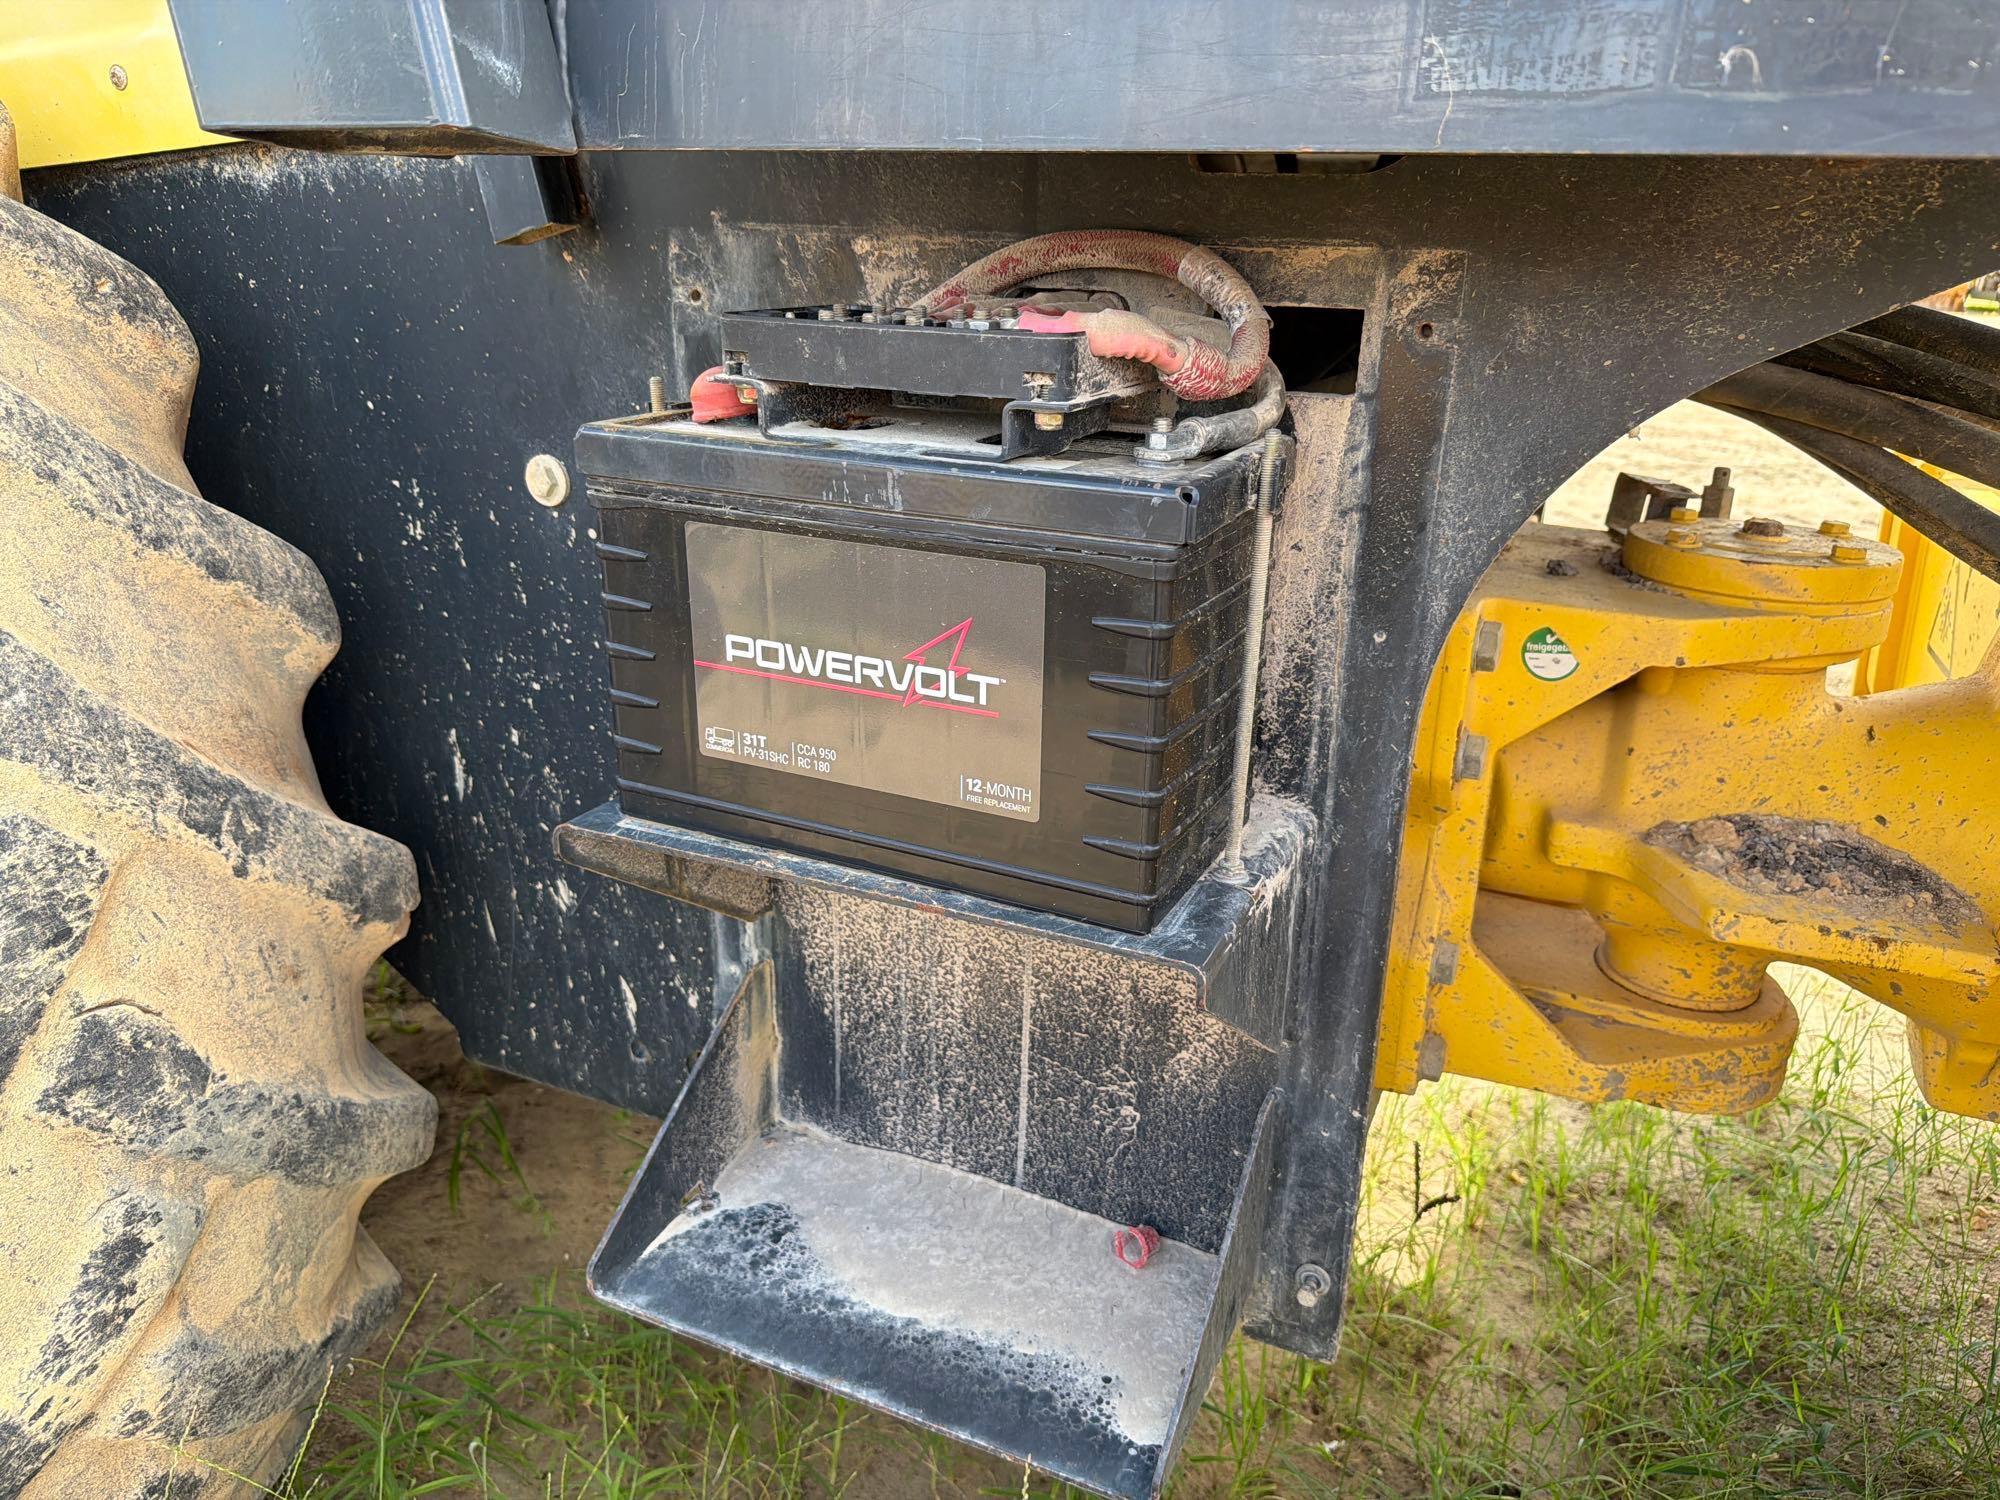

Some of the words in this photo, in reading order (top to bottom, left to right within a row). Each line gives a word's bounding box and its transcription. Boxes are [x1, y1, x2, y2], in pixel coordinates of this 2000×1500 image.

[705, 742, 736, 755] COMMERCIAL
[743, 732, 767, 748] 31T
[744, 746, 789, 765] PV-31SHC
[797, 743, 817, 757] CCA
[819, 747, 837, 761] 950
[797, 756, 811, 769] RC
[813, 760, 830, 773] 180
[966, 778, 1032, 803] 12-MONTH
[966, 794, 983, 805] FREE
[983, 797, 1032, 814] REPLACEMENT
